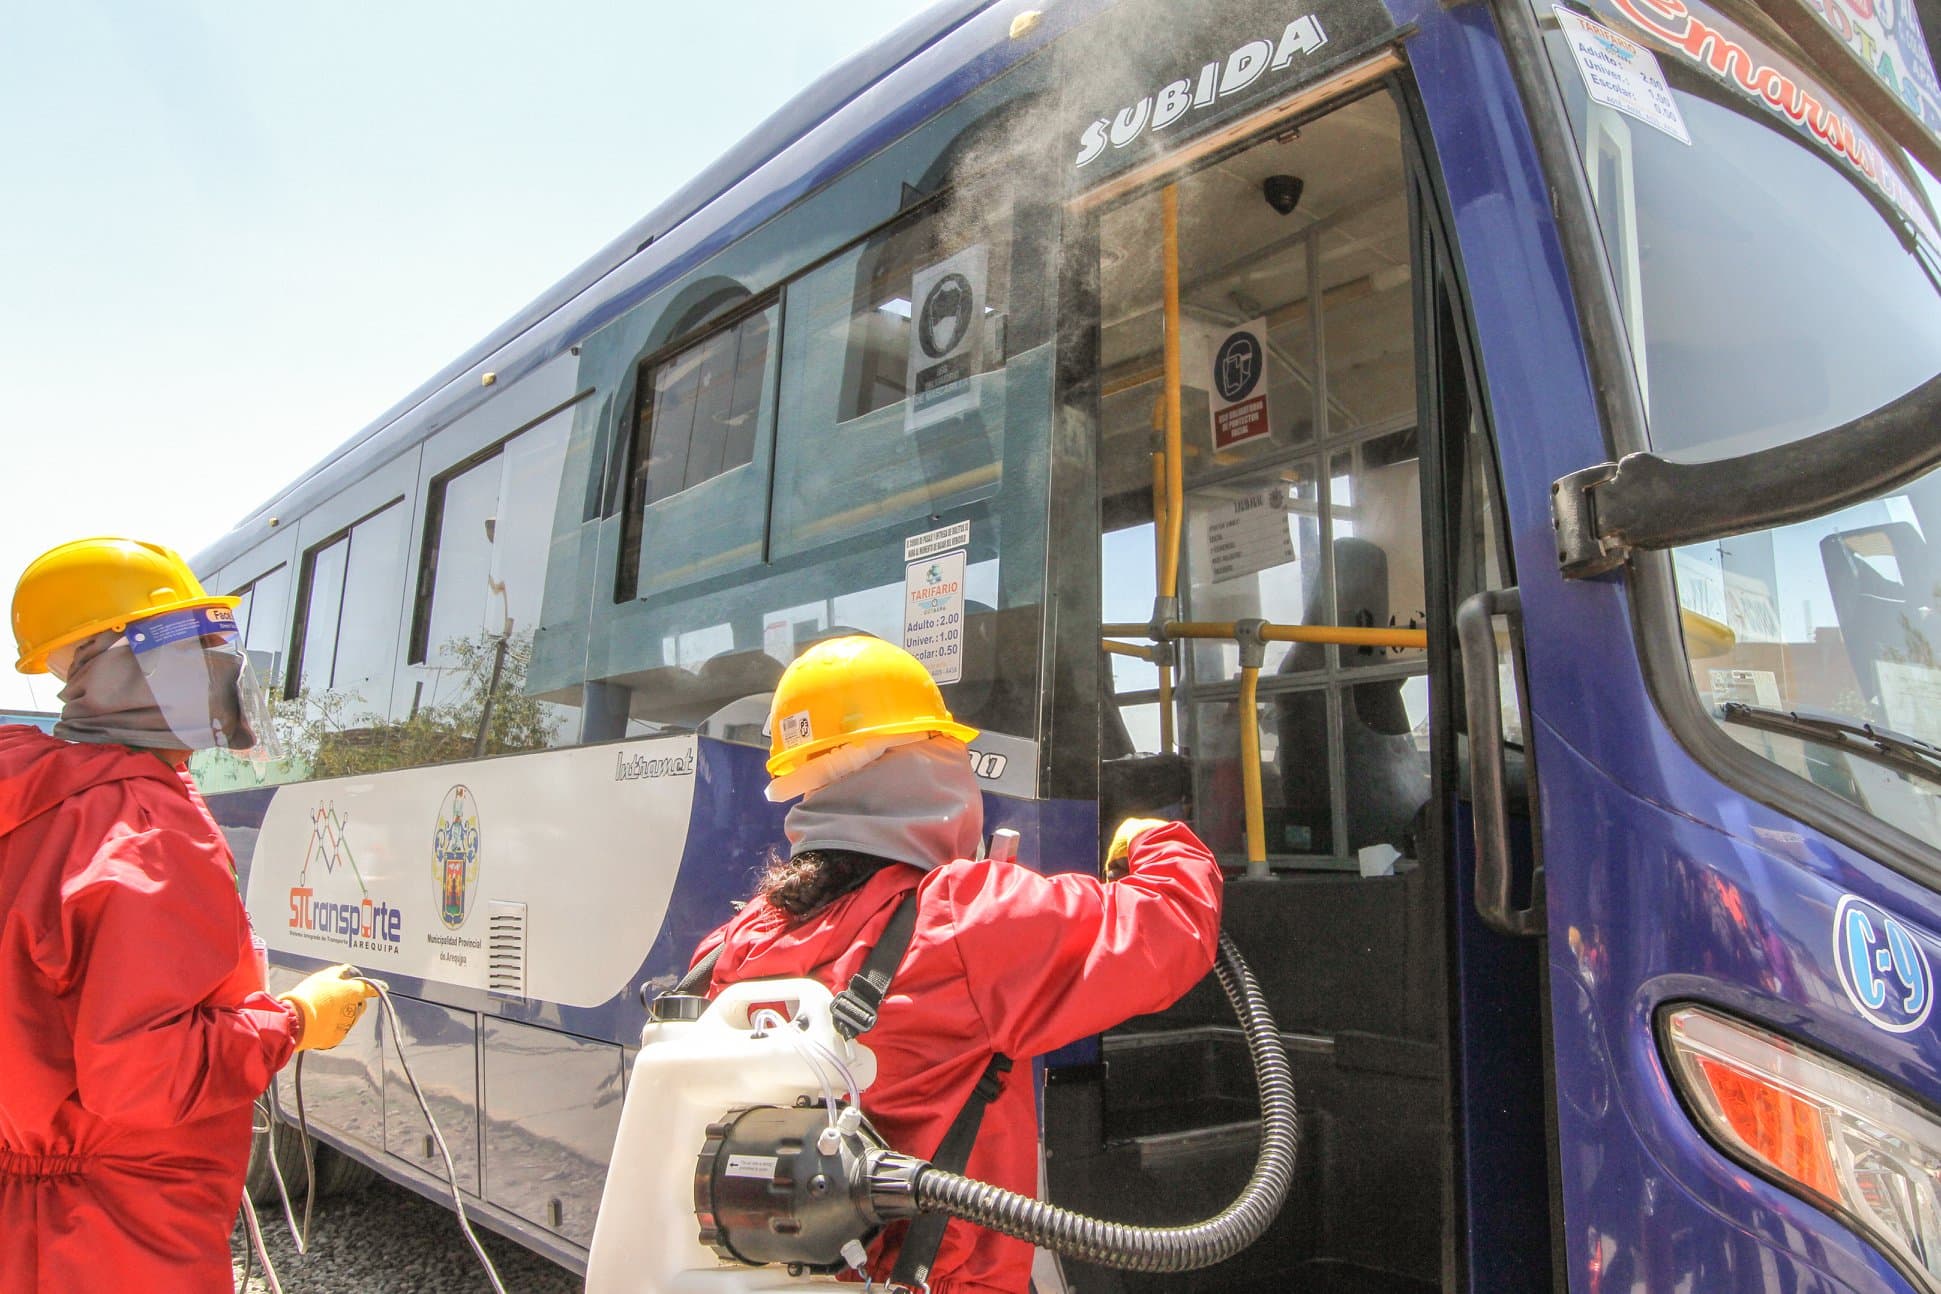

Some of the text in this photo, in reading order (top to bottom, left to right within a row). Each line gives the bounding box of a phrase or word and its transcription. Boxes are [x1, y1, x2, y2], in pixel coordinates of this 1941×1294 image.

[1075, 13, 1329, 168] SUBIDA
[911, 582, 958, 601] TARIFARIO
[938, 644, 958, 657] 0.50
[353, 940, 399, 954] AREQUIPA
[427, 933, 481, 949] Municipalidad Provincial
[446, 952, 467, 966] Arequipa
[1846, 908, 1925, 1014] C-9
